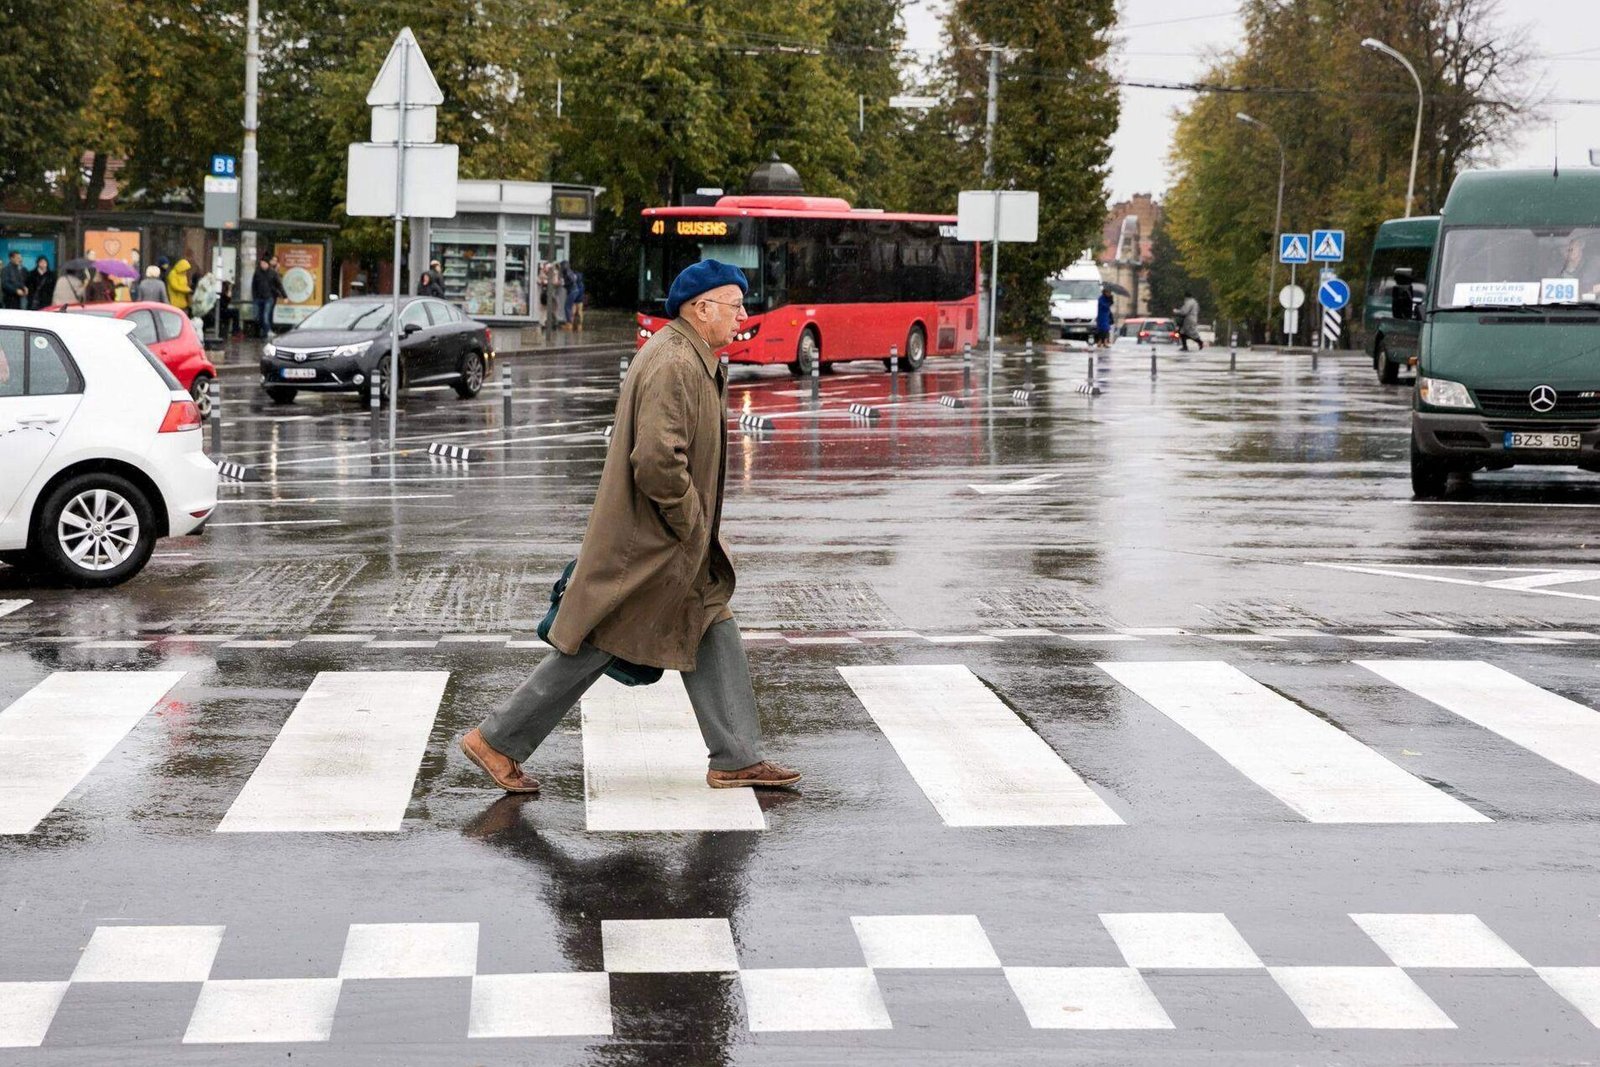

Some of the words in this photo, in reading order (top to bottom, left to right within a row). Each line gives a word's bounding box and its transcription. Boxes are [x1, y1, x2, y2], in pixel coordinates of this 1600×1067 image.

[651, 220, 665, 234] 41
[1469, 284, 1525, 292] LENTVARIS
[1545, 283, 1574, 299] 269
[1513, 434, 1543, 446] BZS
[1553, 435, 1579, 447] 505
